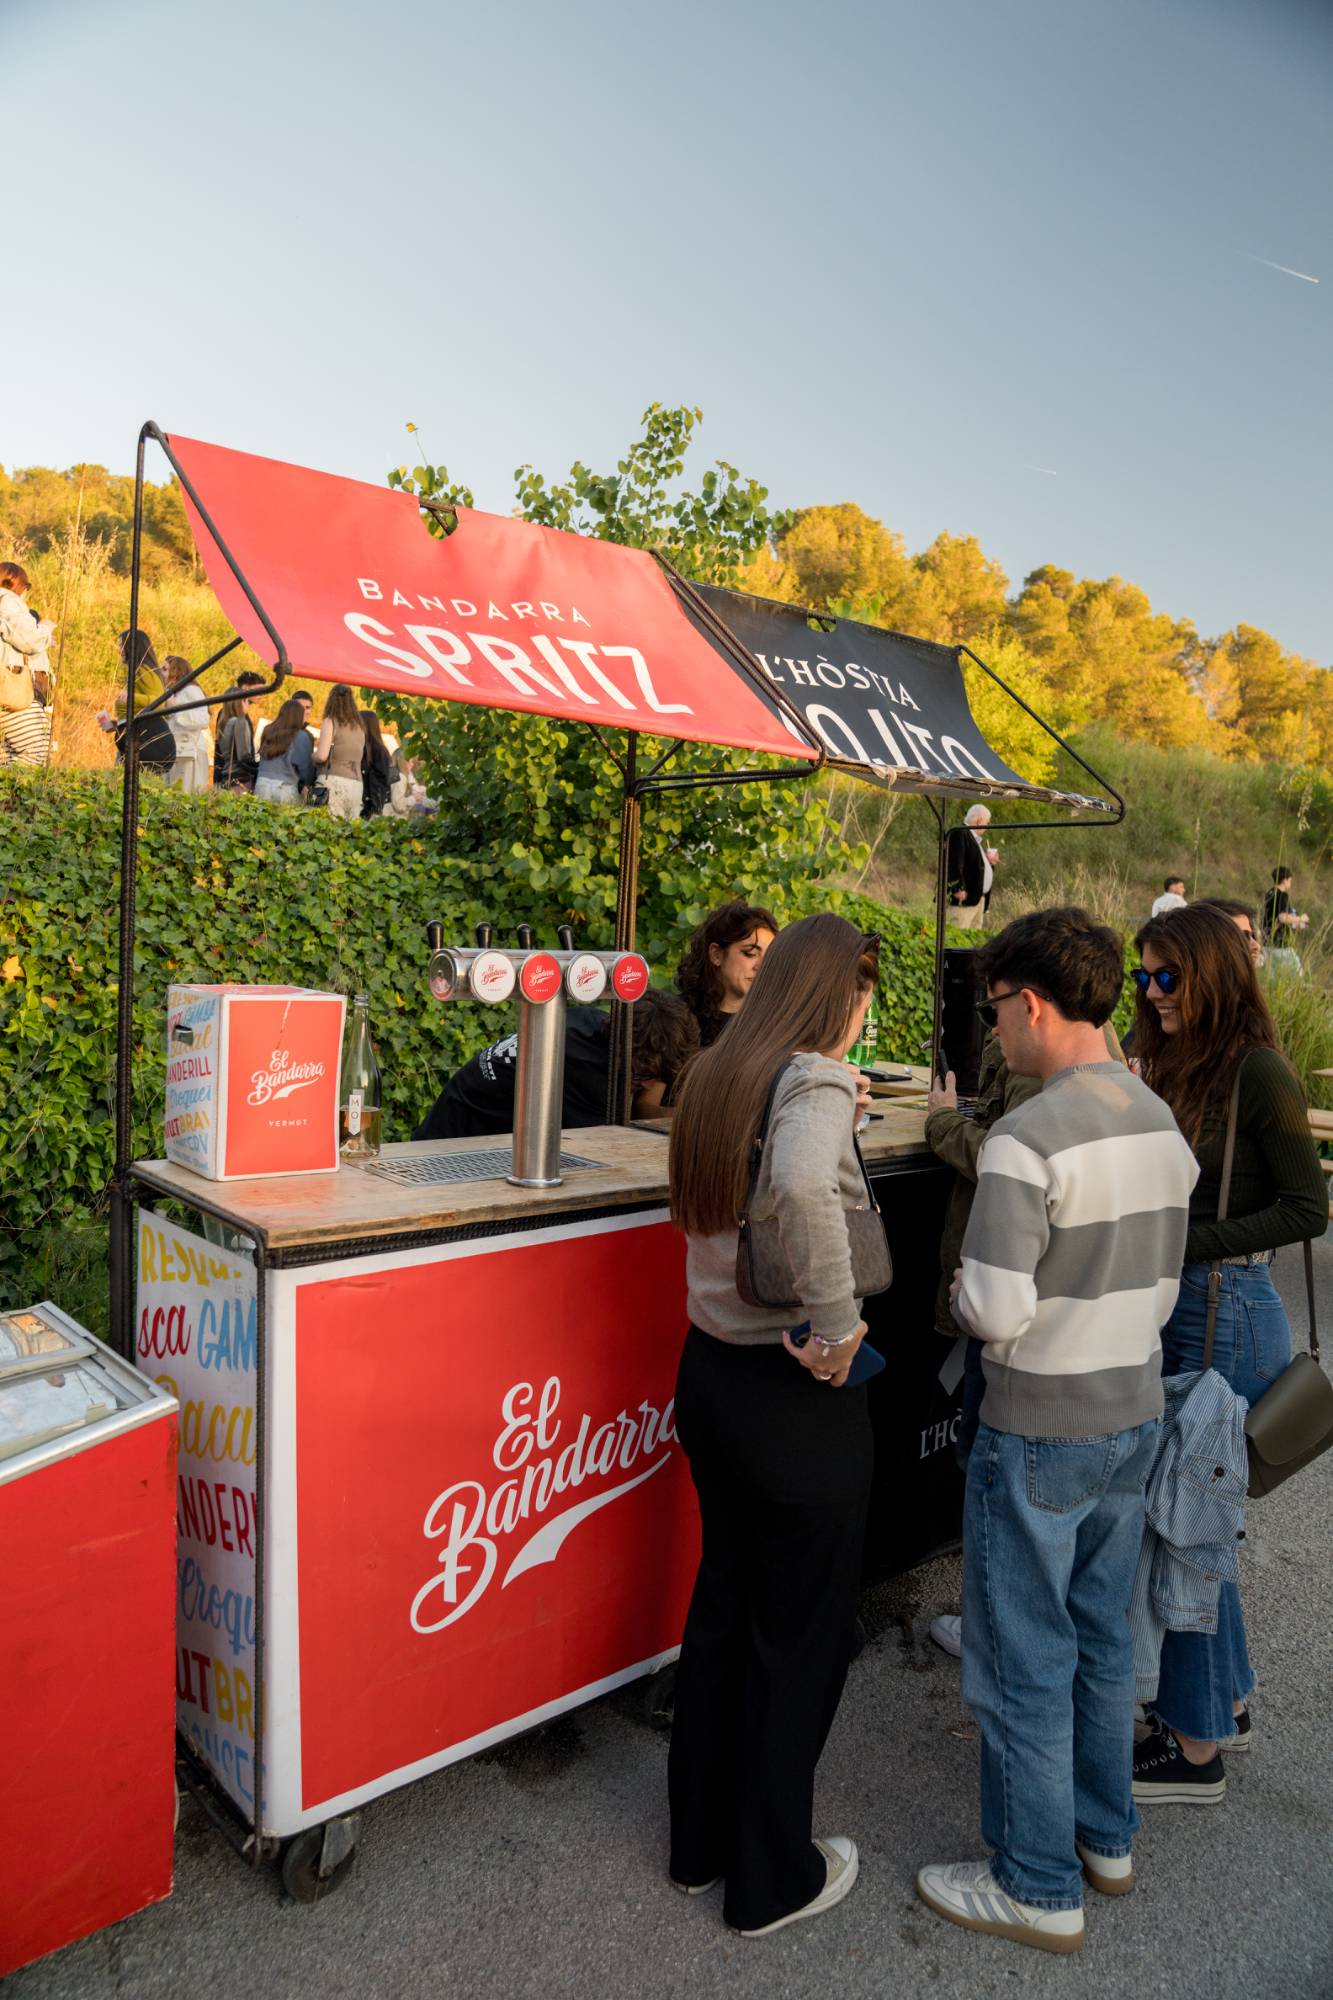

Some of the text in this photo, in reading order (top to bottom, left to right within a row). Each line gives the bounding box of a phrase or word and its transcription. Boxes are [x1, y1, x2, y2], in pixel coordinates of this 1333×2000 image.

[356, 577, 592, 628] BANDARRA
[343, 612, 696, 716] SPRITZ
[777, 698, 998, 782] OJITO
[247, 1061, 326, 1106] Bandarra
[269, 1050, 290, 1072] El
[268, 1119, 308, 1127] VERMUT
[493, 1375, 562, 1472] El
[213, 1657, 266, 1740] BR
